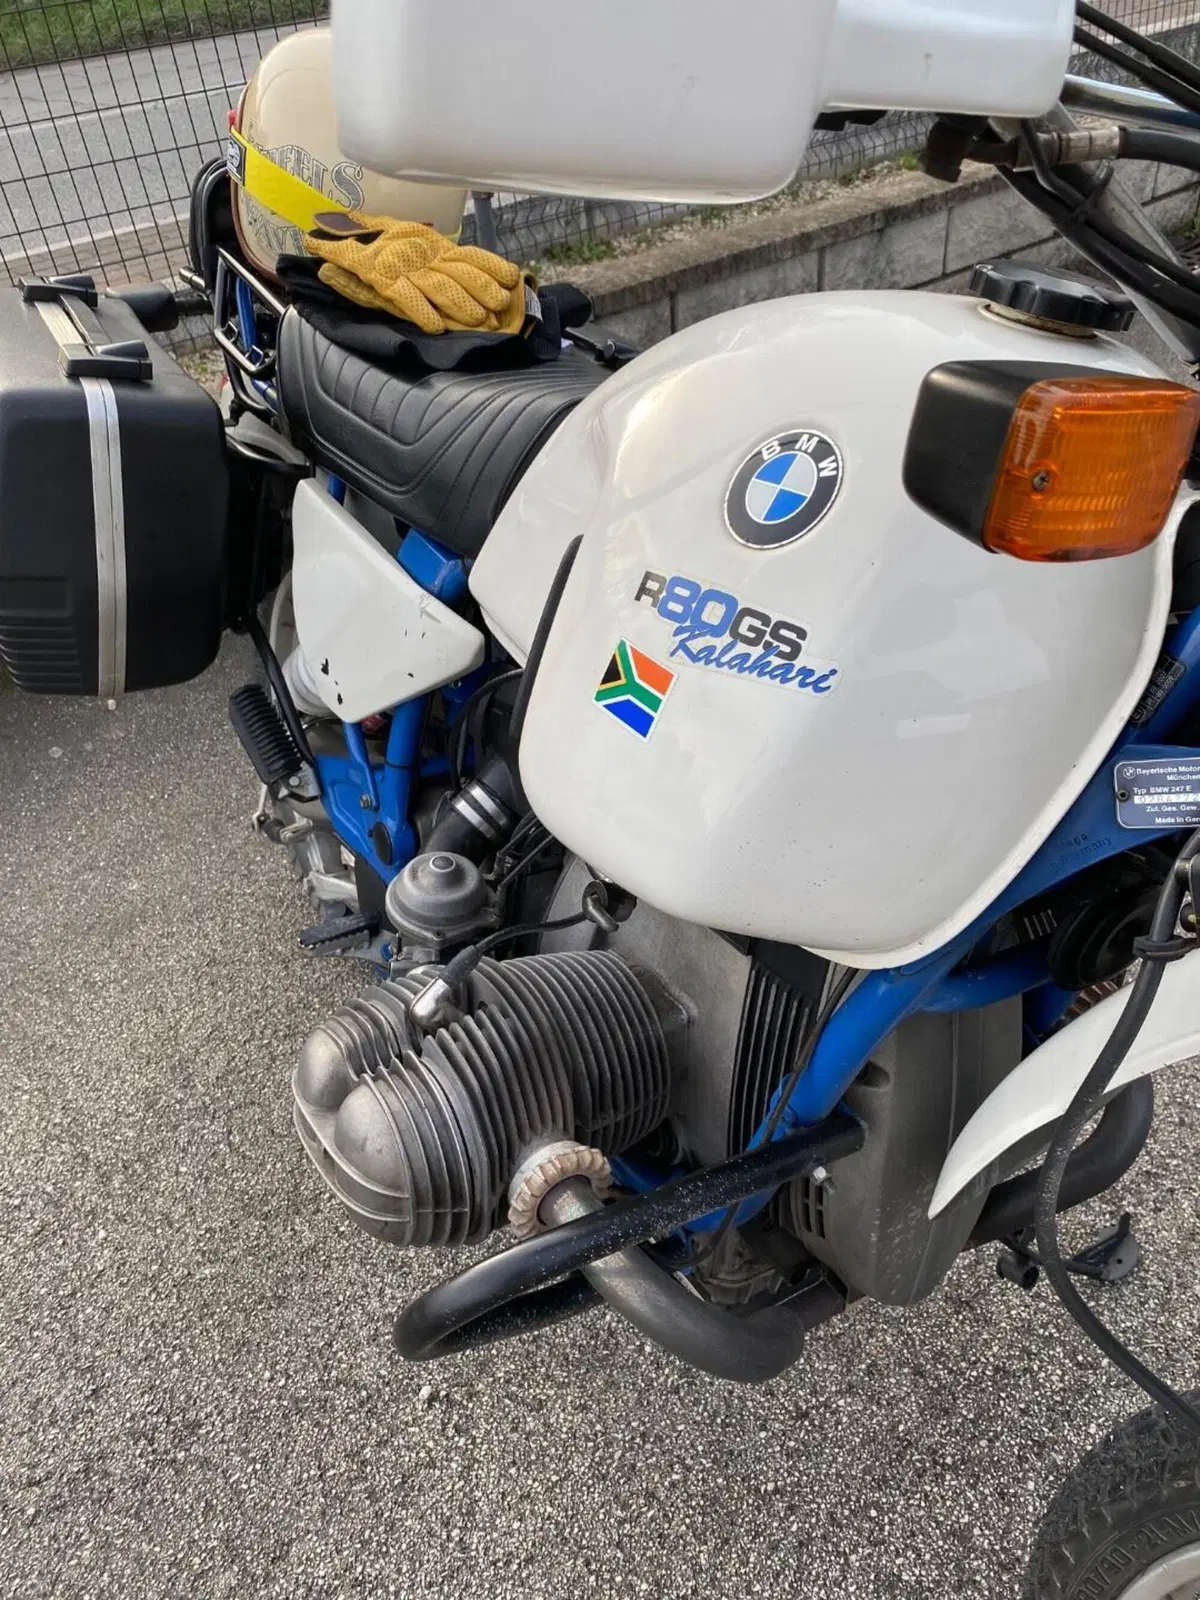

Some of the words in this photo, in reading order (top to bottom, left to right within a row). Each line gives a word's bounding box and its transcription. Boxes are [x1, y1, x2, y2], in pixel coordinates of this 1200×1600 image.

[761, 433, 838, 478] BMW
[670, 623, 838, 694] Kalahari
[1136, 766, 1177, 776] Bayerische
[1133, 787, 1147, 795] Typ
